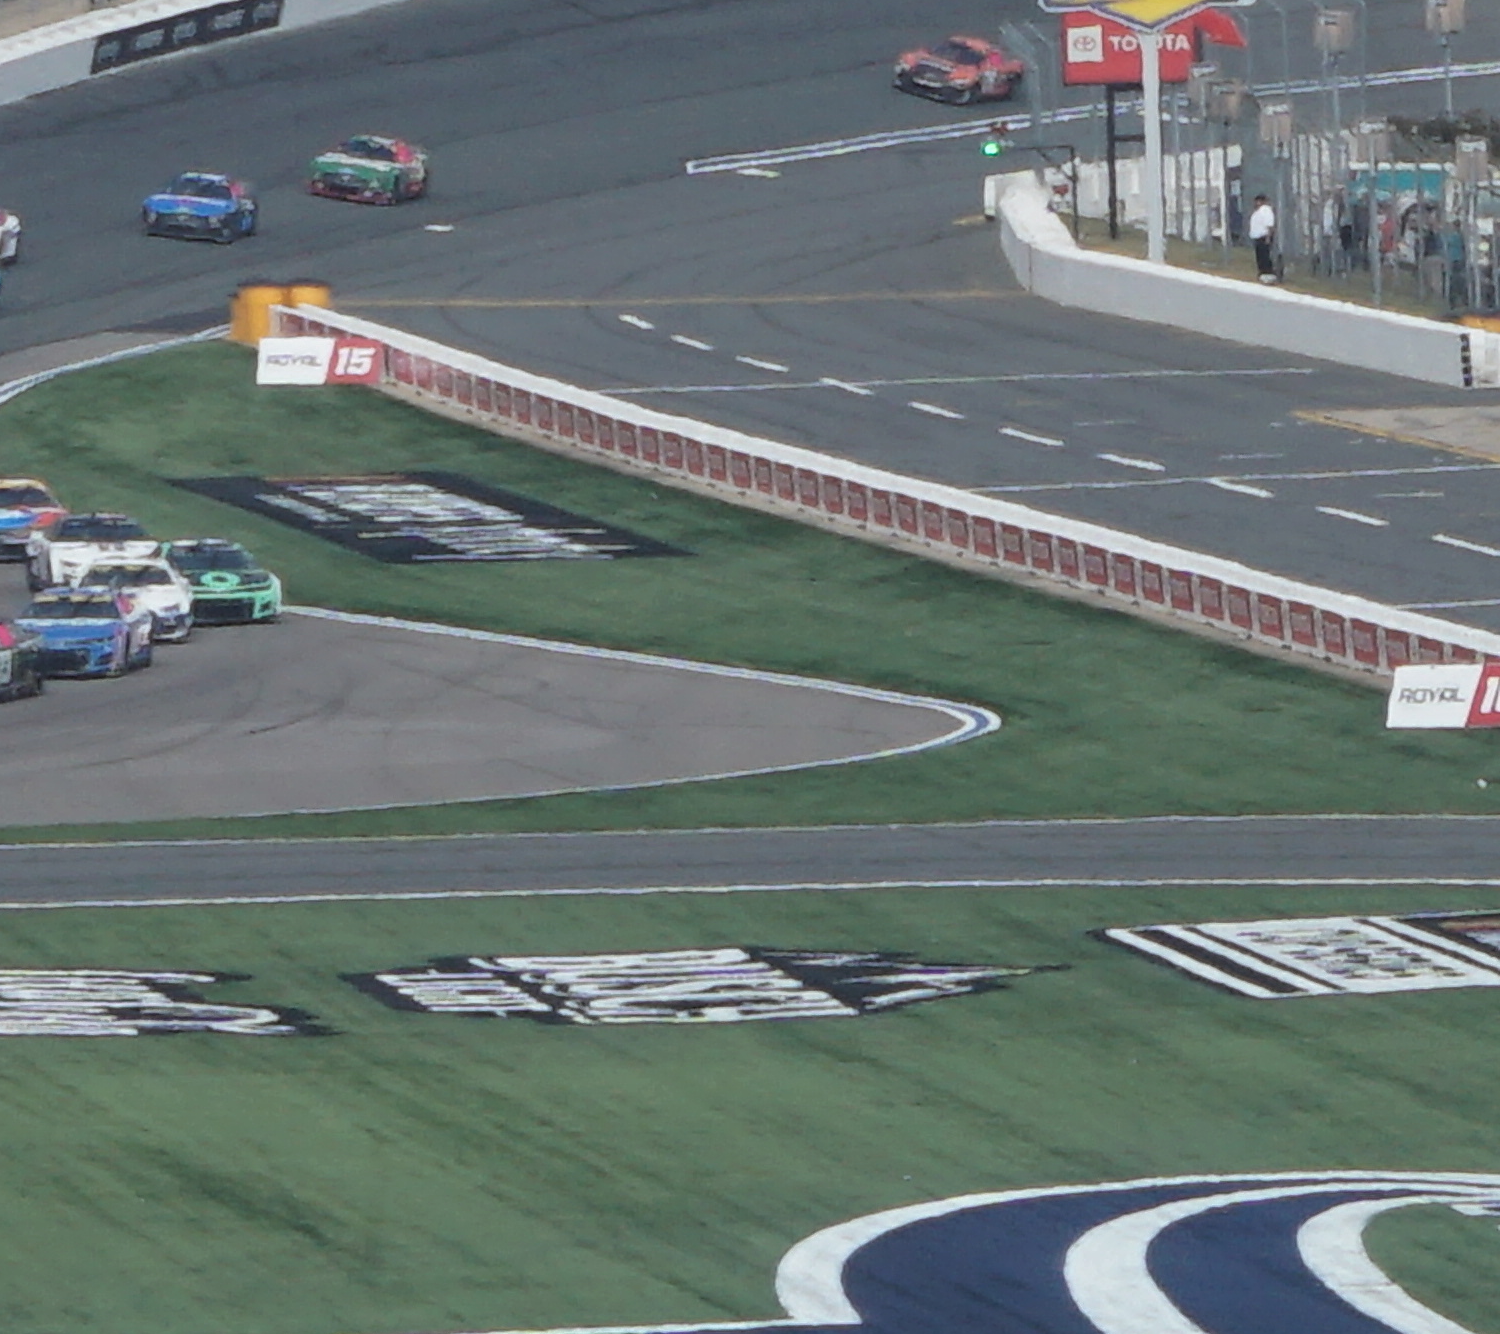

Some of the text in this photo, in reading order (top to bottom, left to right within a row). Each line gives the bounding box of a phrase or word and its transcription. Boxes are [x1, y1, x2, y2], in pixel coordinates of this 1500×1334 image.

[1108, 33, 1190, 52] TOOTA
[334, 347, 375, 376] 15
[485, 948, 859, 1024] BUSCH
